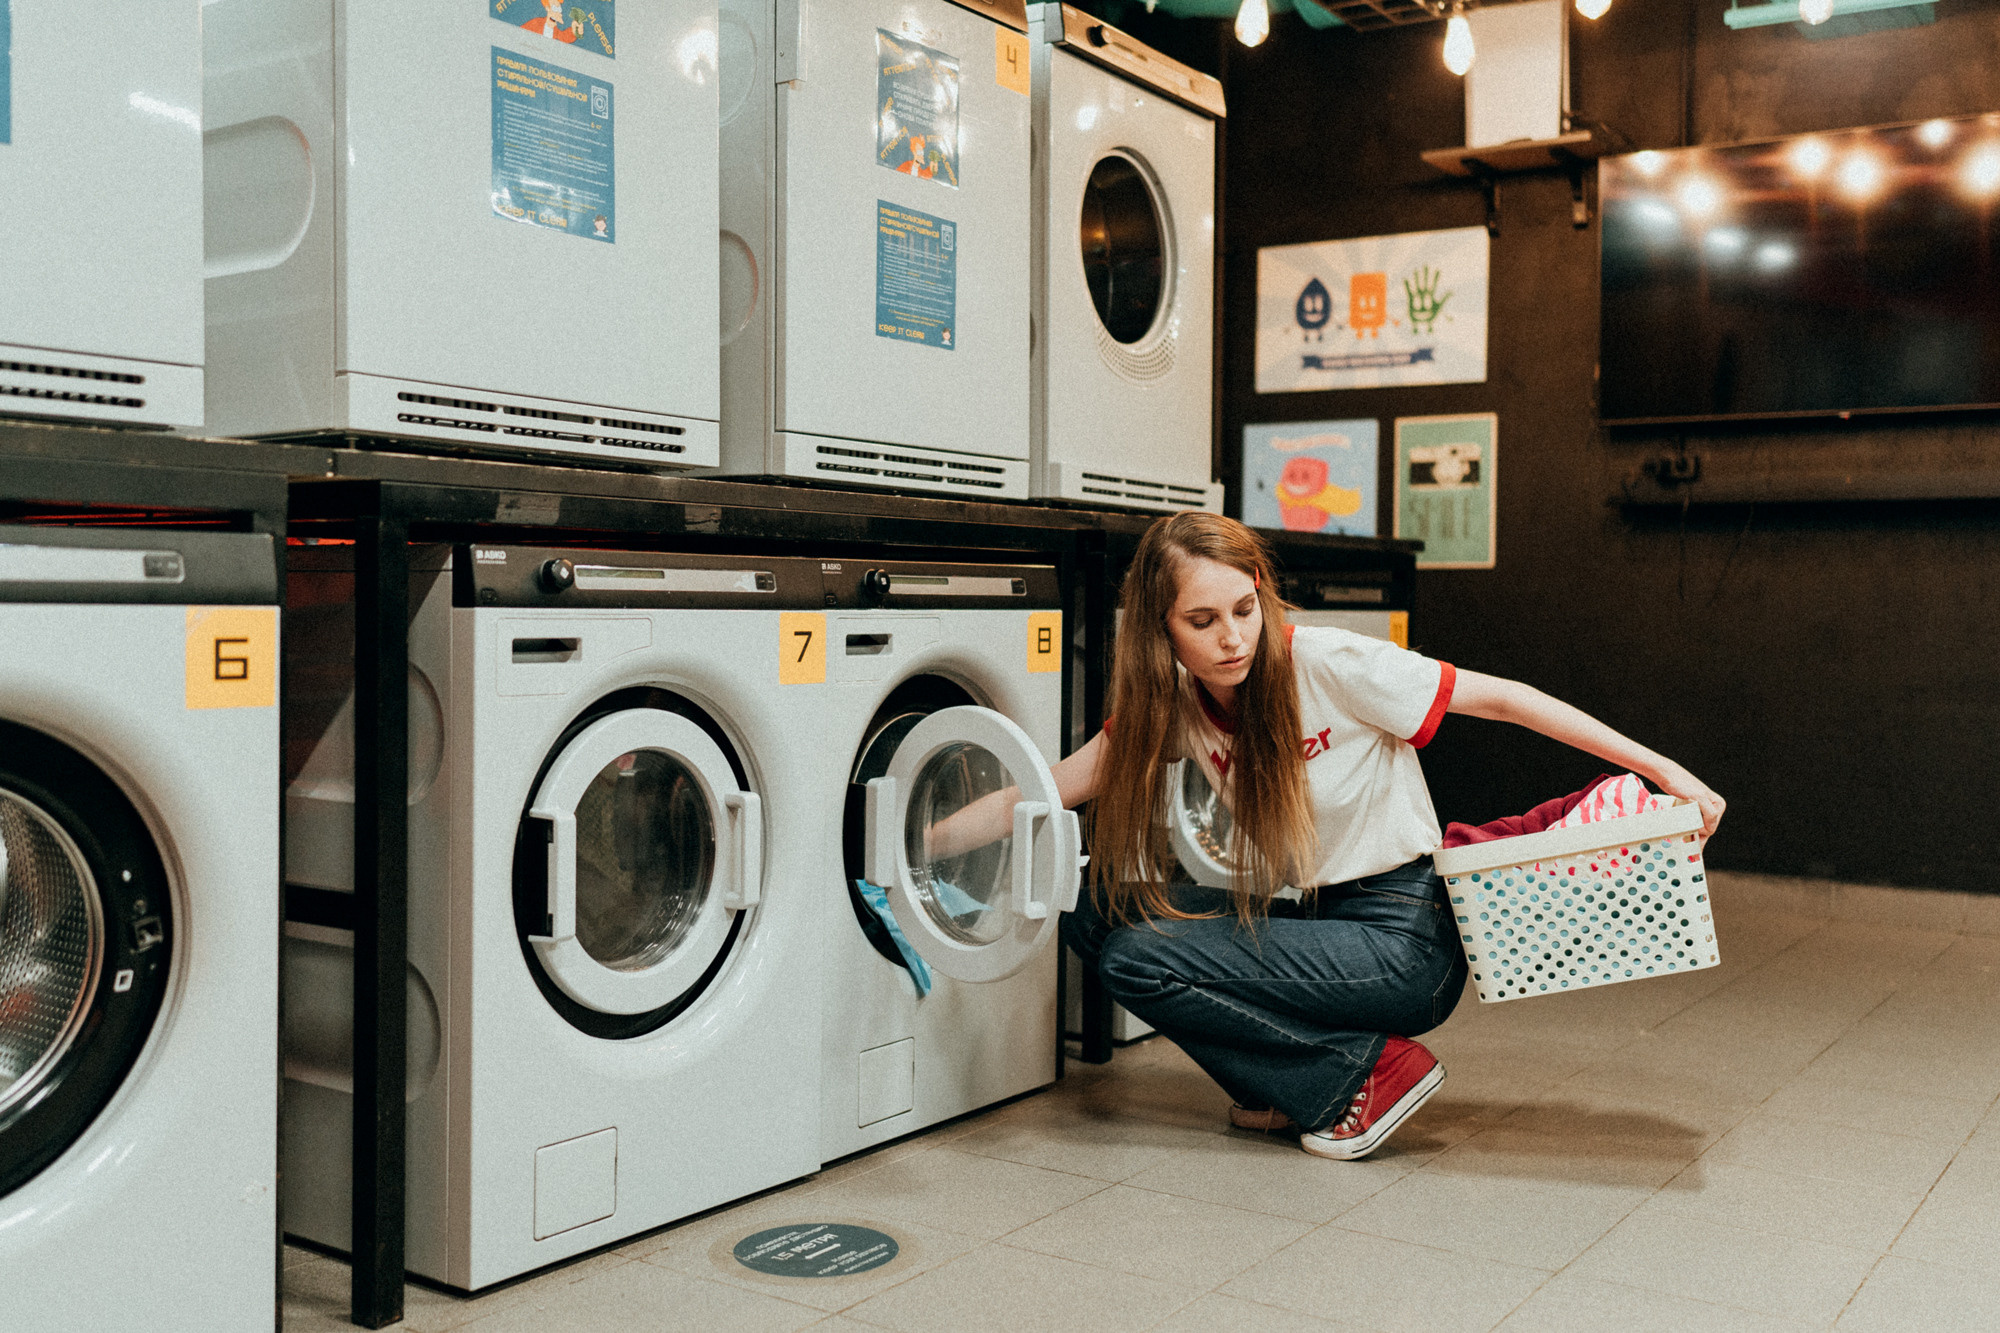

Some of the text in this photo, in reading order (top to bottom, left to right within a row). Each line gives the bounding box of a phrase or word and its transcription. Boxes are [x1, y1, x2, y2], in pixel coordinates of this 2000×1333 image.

[1006, 45, 1017, 74] 4
[527, 210, 536, 220] IT
[484, 550, 507, 560] ASKO
[826, 563, 842, 571] ASKO
[793, 631, 813, 663] 7
[1037, 627, 1051, 654] 8
[214, 637, 249, 681] 6
